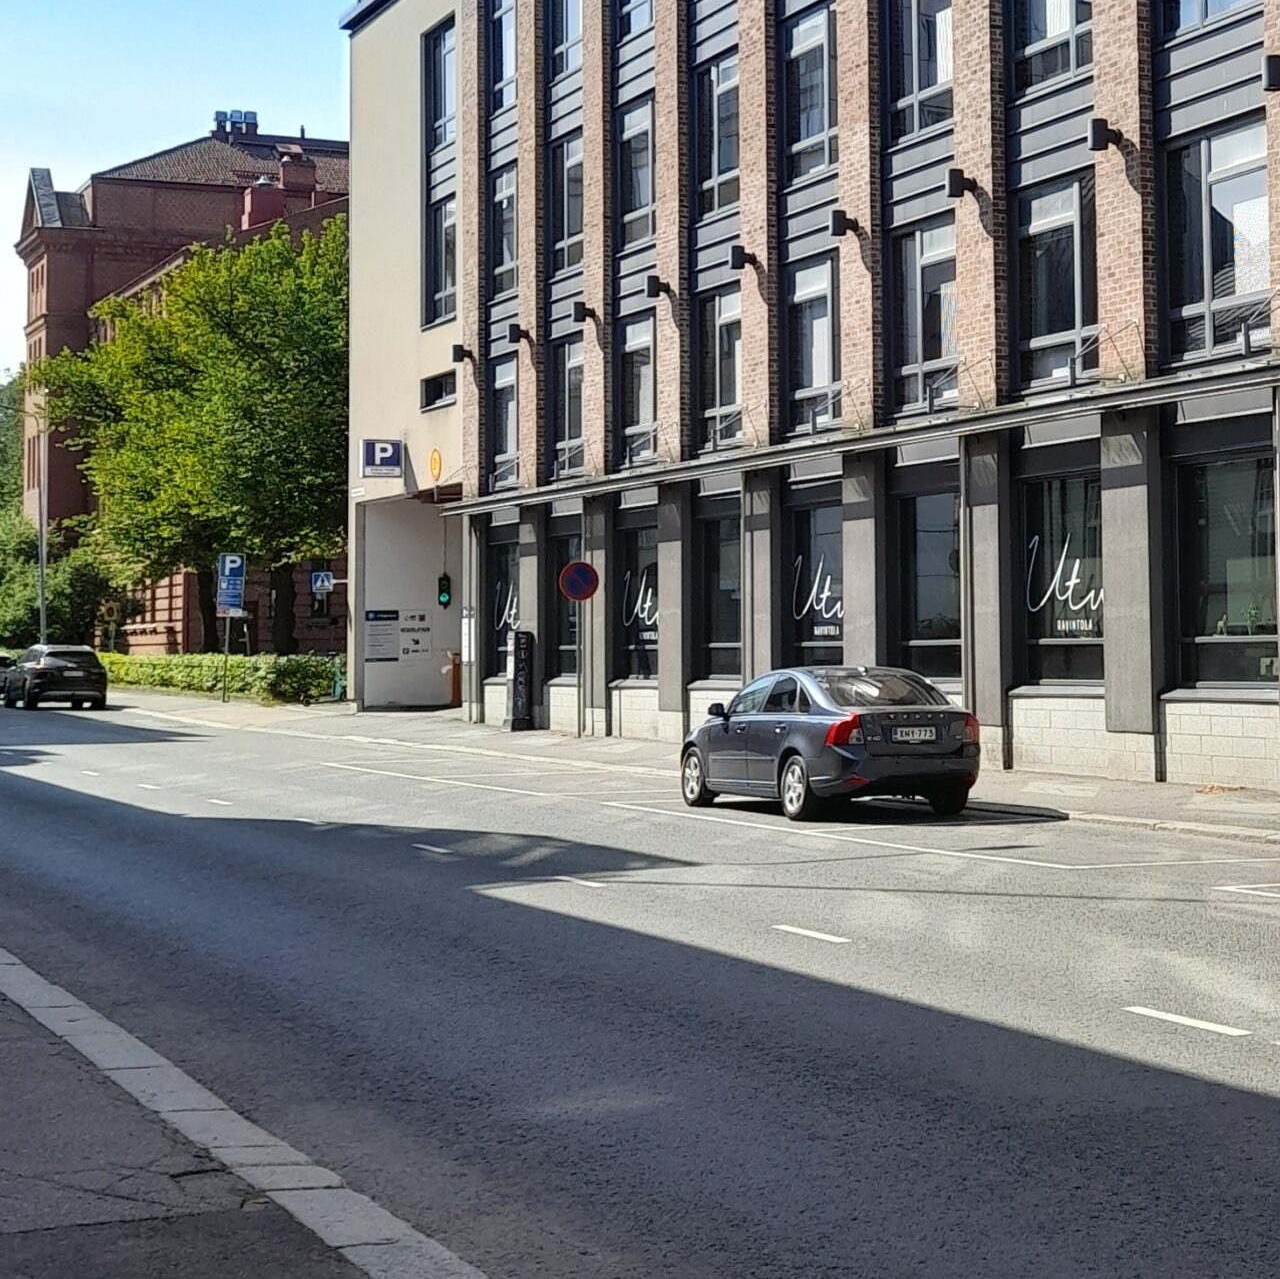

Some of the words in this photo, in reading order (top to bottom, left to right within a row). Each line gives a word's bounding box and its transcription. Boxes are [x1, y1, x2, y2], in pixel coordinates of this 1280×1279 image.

[374, 443, 394, 465] P
[224, 555, 242, 576] P
[622, 569, 660, 627] Ut
[1056, 619, 1093, 631] RAVINTOLA
